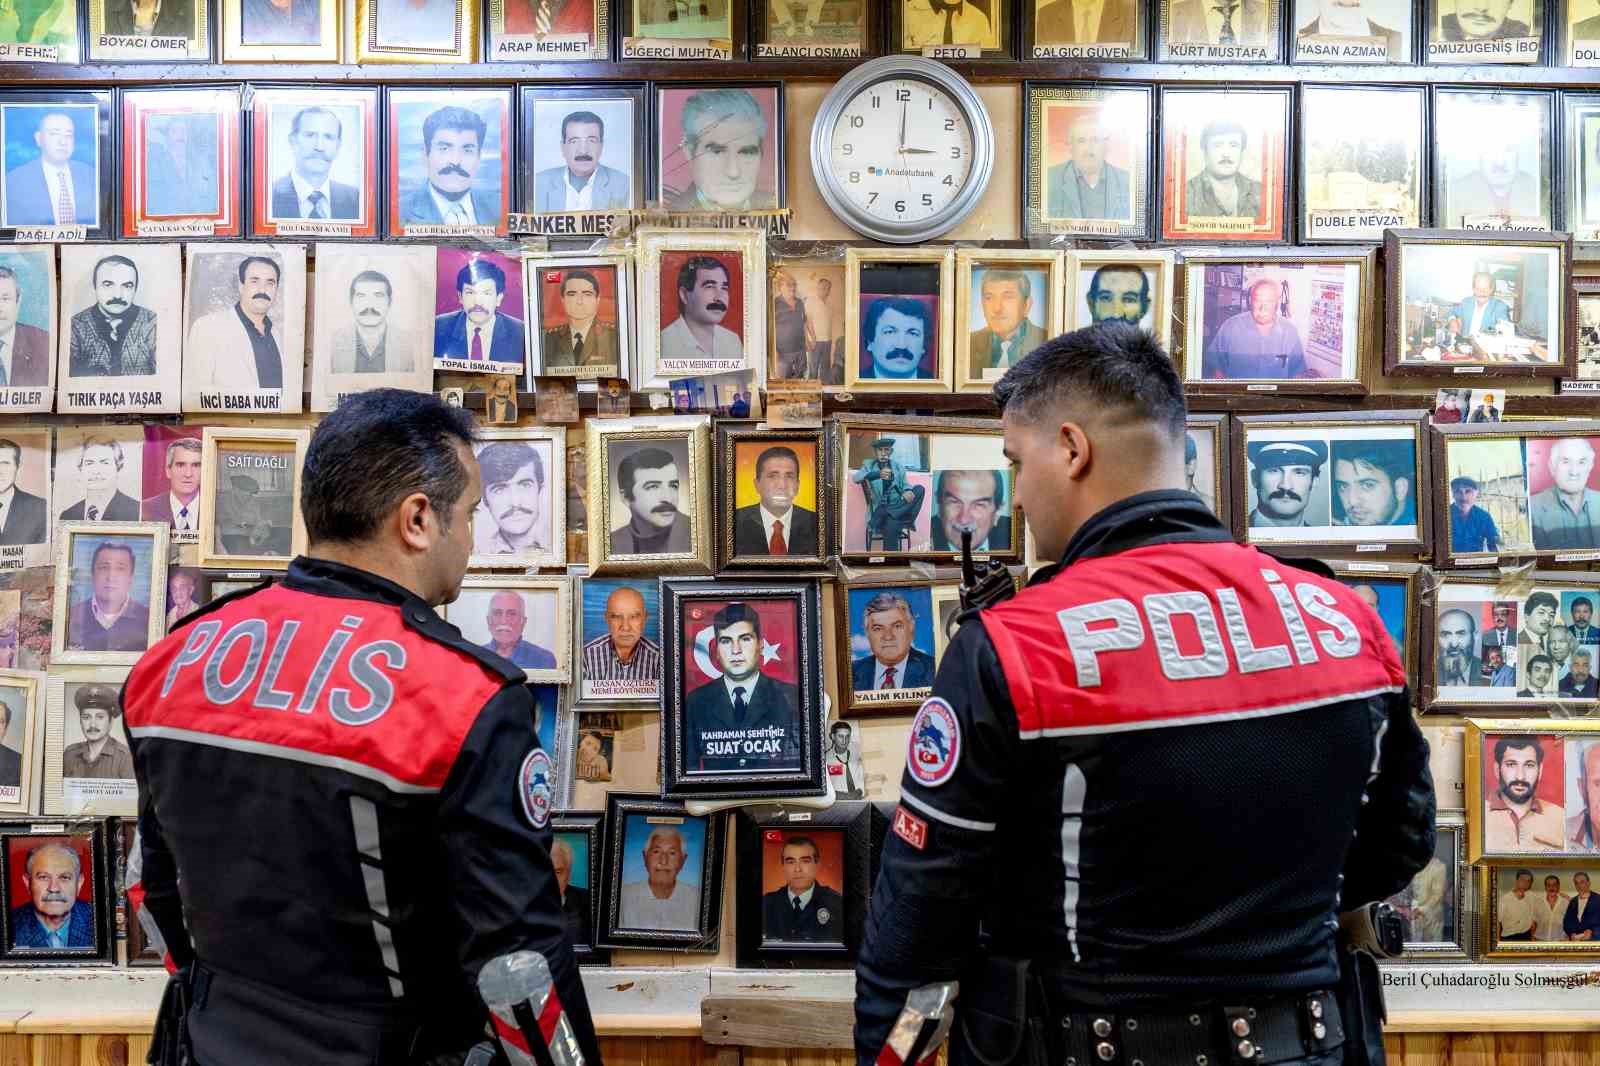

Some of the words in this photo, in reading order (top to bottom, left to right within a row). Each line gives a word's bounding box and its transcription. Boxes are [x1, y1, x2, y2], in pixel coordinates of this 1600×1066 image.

[99, 36, 147, 48] BOYACI
[499, 42, 533, 52] ARAP
[536, 41, 588, 52] MEHMET
[814, 47, 859, 57] OSMAN
[934, 48, 967, 59] PETO
[1207, 47, 1267, 58] MUSTAFA
[1297, 44, 1340, 56] HASAN
[1342, 46, 1386, 57] AZMAN
[896, 89, 911, 102] 12
[872, 96, 881, 109] 11
[850, 115, 864, 129] 10
[944, 119, 954, 131] 2
[842, 143, 853, 155] 9
[951, 146, 961, 159] 3
[849, 171, 860, 183] 8
[942, 174, 953, 186] 4
[868, 192, 879, 205] 7
[921, 193, 933, 206] 5
[894, 200, 906, 212] 6
[508, 214, 577, 233] BANKER
[581, 214, 616, 233] MES
[1315, 216, 1356, 227] DUBLE
[1359, 215, 1405, 227] NEVZAT
[441, 360, 468, 370] TOPAL
[67, 393, 97, 407] TIRIK
[99, 392, 126, 410] PAÇA
[129, 391, 163, 409] YAŞAR
[199, 392, 222, 409] İNCİ
[224, 395, 252, 409] BABA
[253, 392, 280, 409] NURİ
[1056, 568, 1362, 688] POLİS
[160, 615, 407, 727] POLİS
[701, 730, 746, 740] KAHRAMAN
[706, 739, 740, 755] SUAT
[743, 738, 782, 753] OCAK
